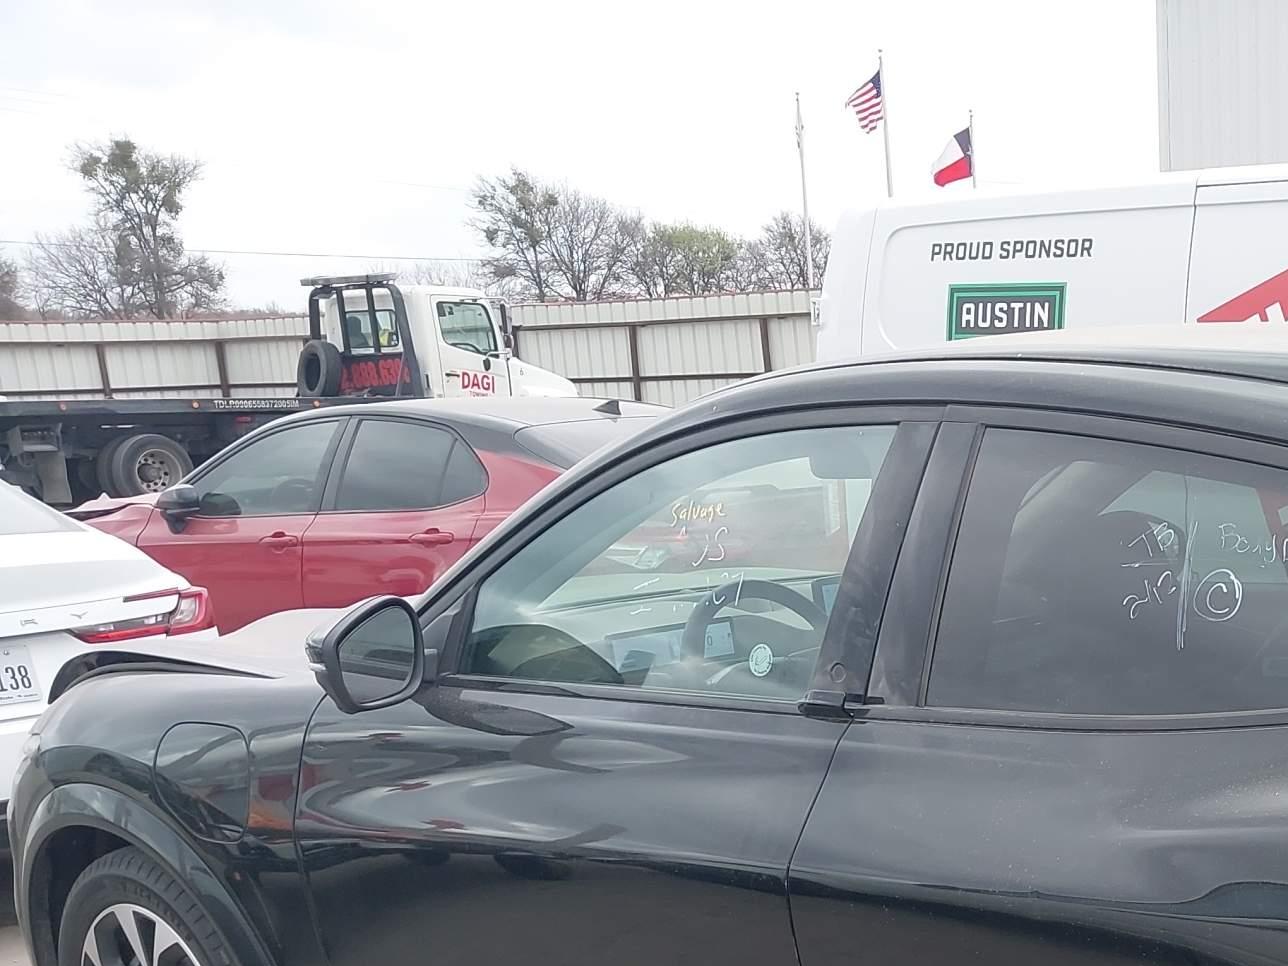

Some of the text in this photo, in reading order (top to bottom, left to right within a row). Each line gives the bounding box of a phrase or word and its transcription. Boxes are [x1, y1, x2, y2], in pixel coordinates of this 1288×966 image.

[930, 238, 1093, 261] PROUD SPONSOR
[960, 301, 1049, 328] AUSTIN
[461, 371, 495, 393] DAGI
[670, 500, 726, 527] Salvage
